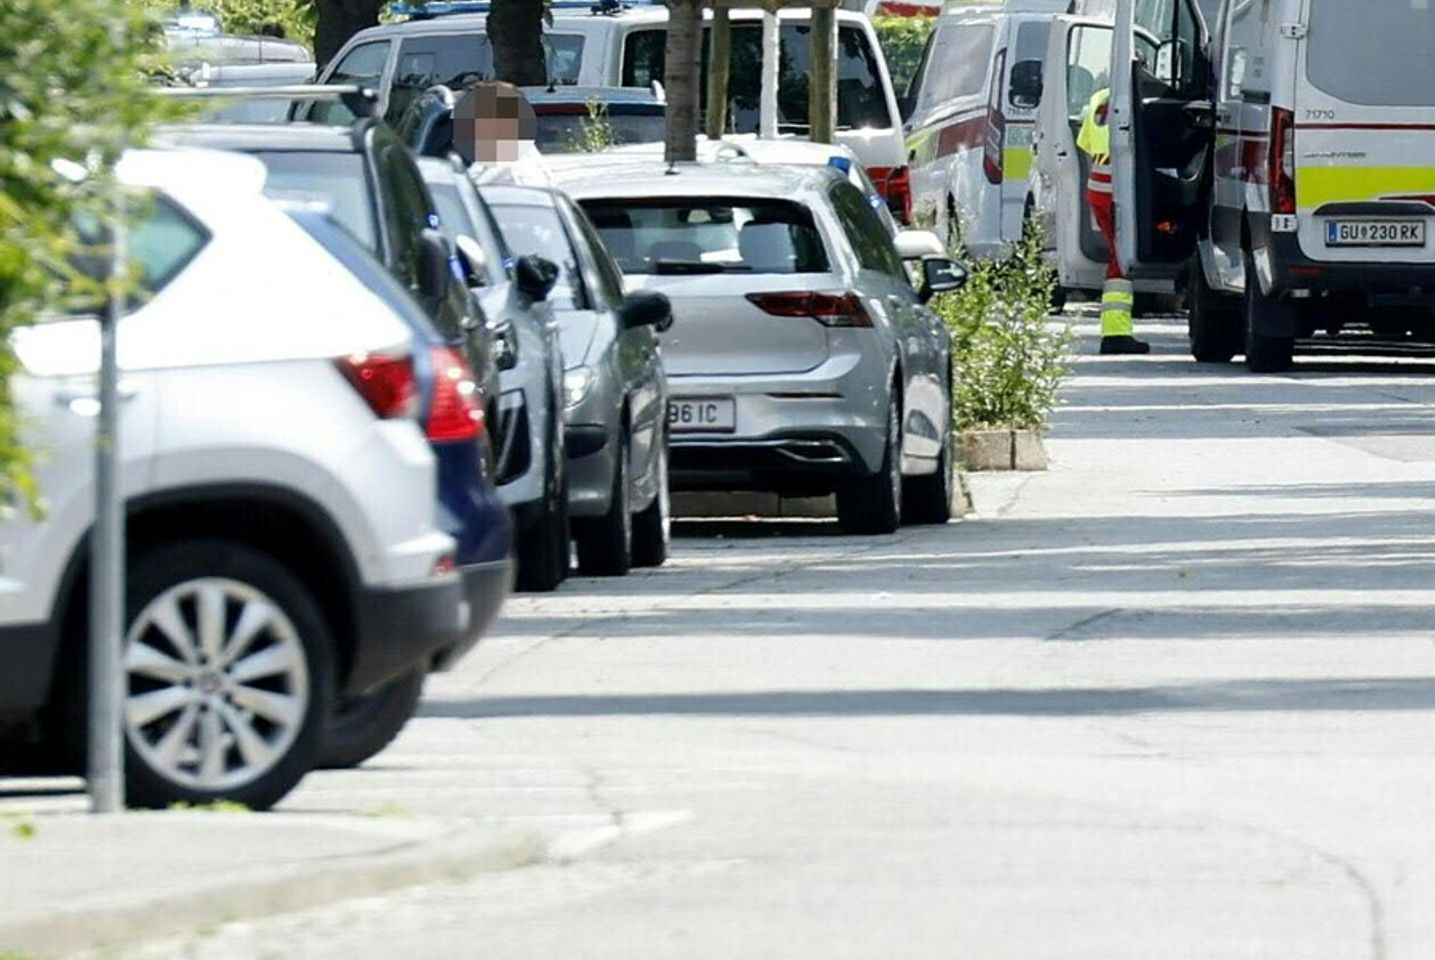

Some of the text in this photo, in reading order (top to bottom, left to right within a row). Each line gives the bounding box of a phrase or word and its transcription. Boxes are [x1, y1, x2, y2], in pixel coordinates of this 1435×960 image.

[1340, 224, 1419, 240] GU 230 RK
